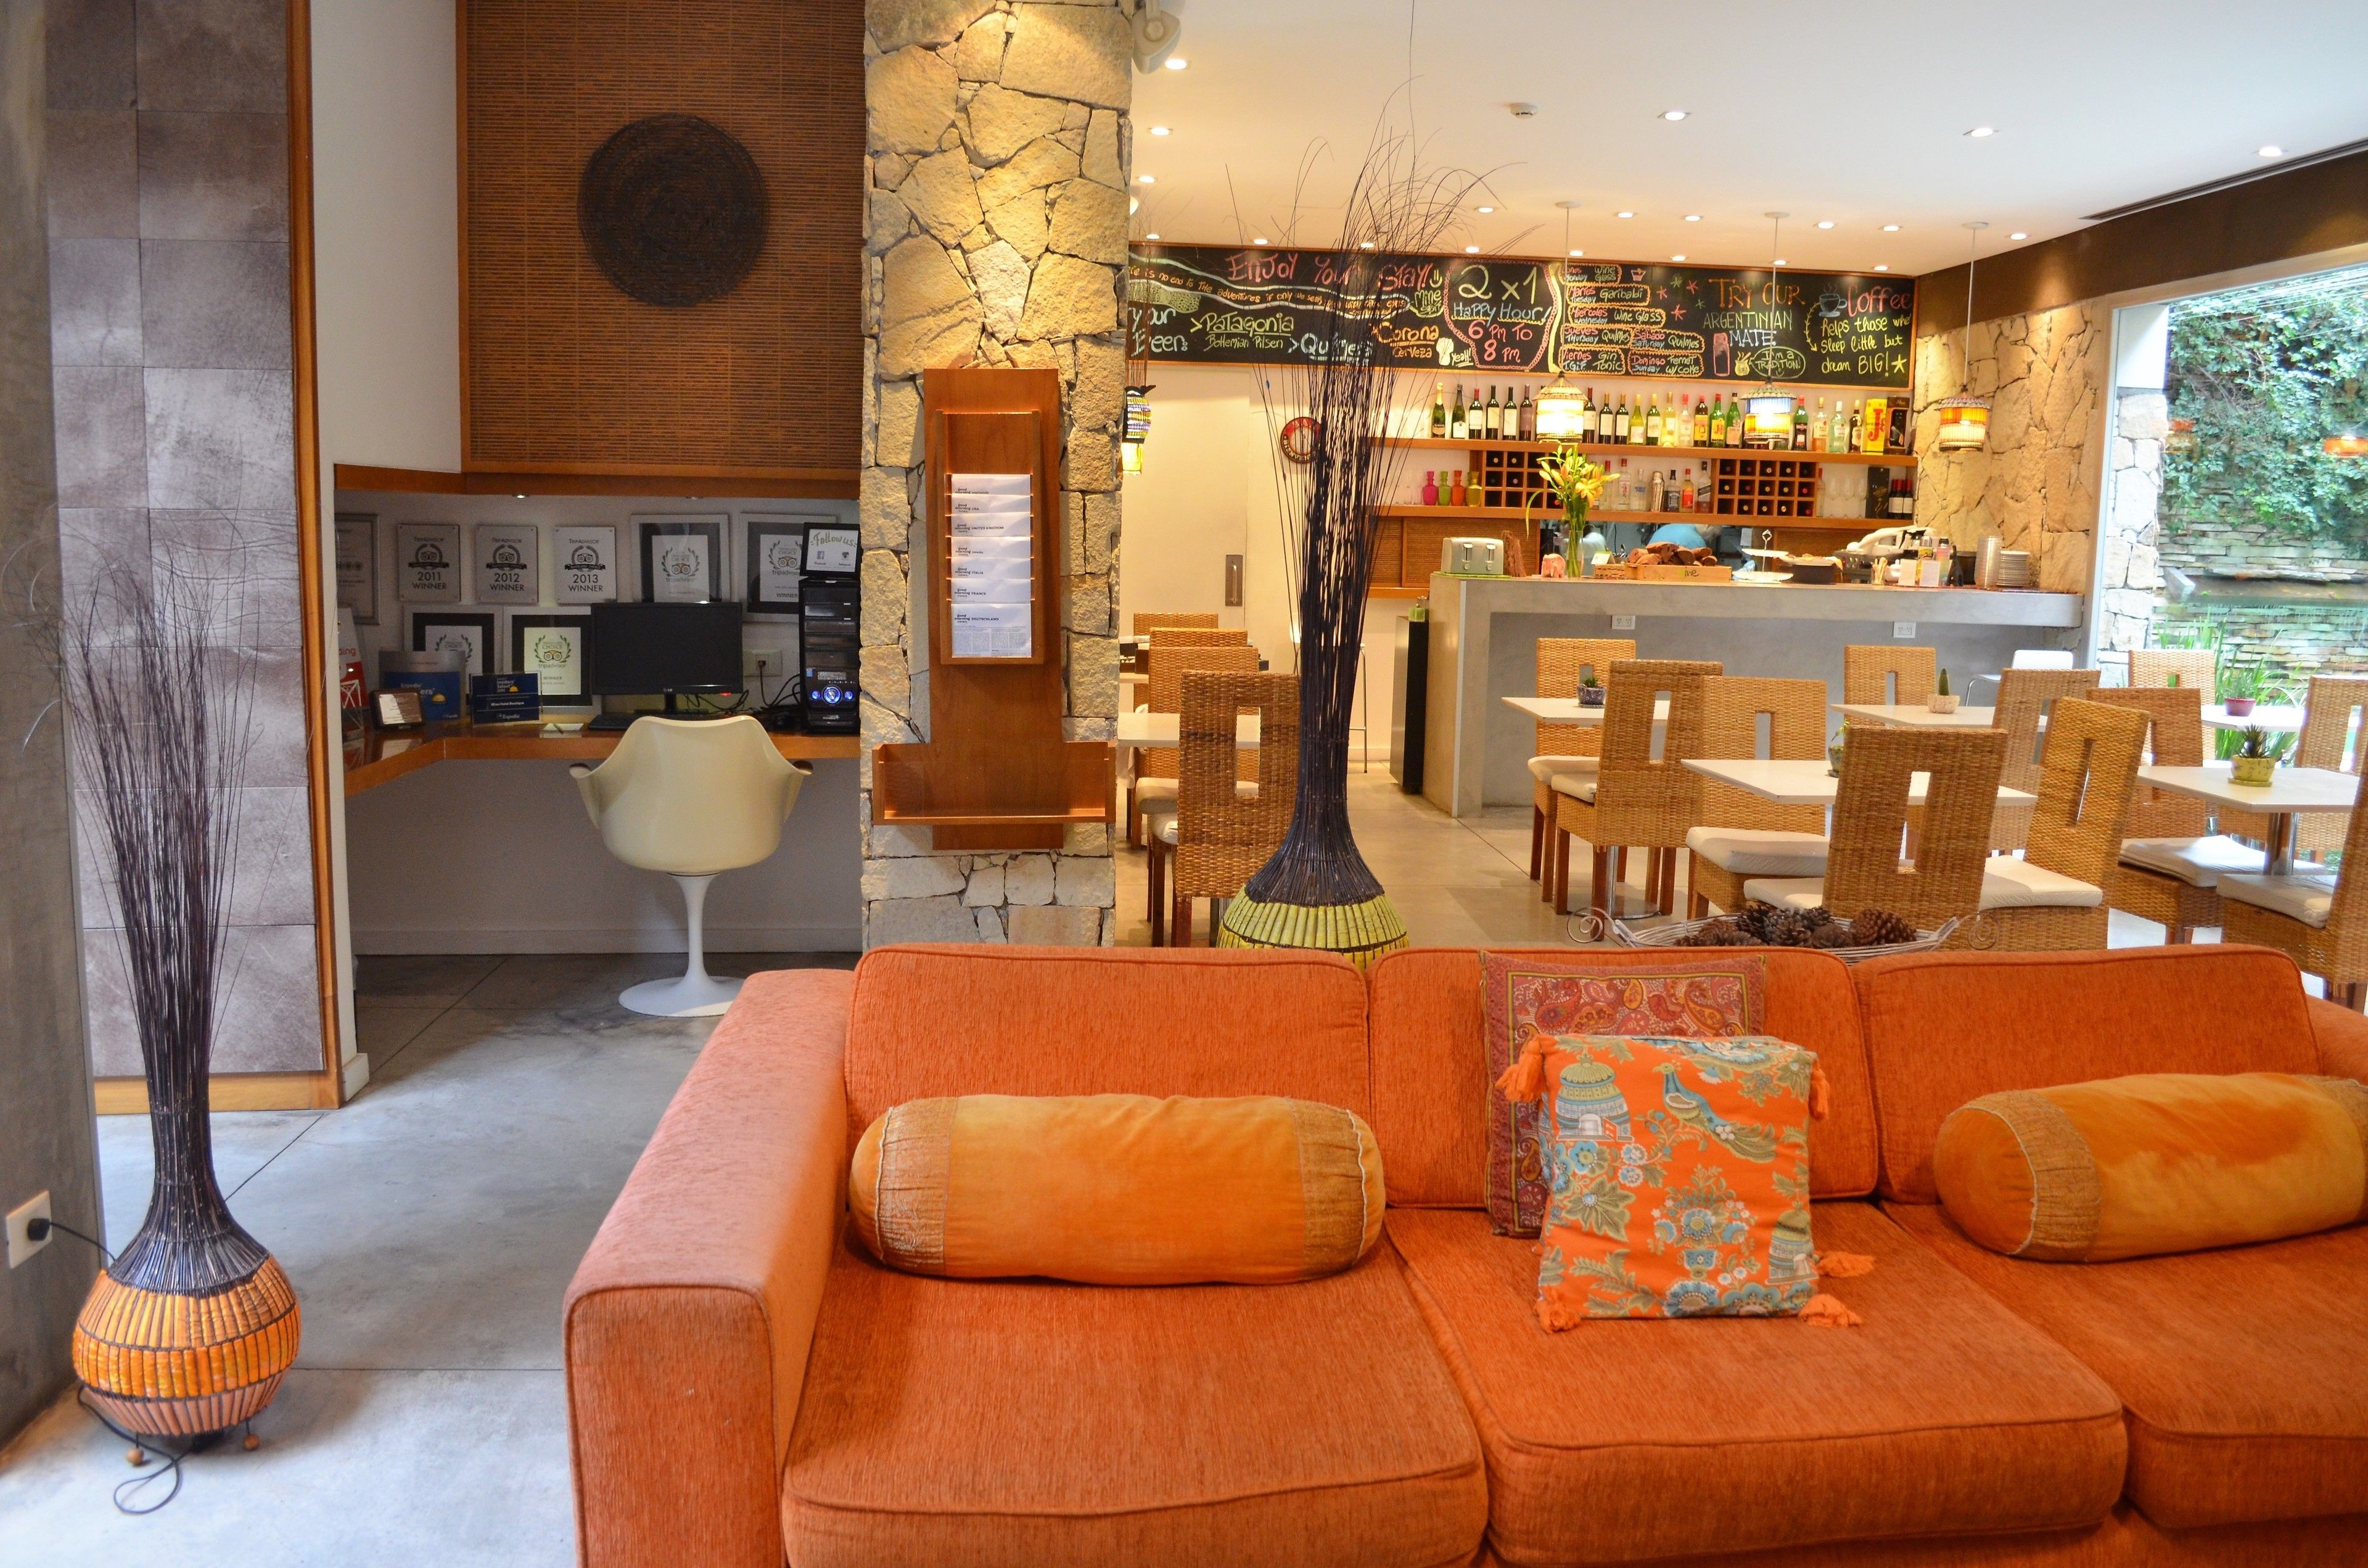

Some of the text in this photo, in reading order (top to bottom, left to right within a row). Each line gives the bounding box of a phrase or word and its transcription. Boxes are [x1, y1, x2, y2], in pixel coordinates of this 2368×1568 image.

[1145, 268, 1155, 278] is
[1266, 293, 1273, 302] if
[1276, 291, 1293, 302] only
[1600, 288, 1643, 302] Garibaldi
[1708, 279, 1754, 308] TRY
[1847, 283, 1912, 317] Coffee
[1453, 302, 1552, 327] Happy Hour!
[1614, 310, 1633, 321] Wine
[1635, 311, 1662, 324] Glass
[1703, 310, 1793, 330] ARGENTINIAN
[1468, 319, 1486, 339] 6
[1854, 316, 1888, 333] those
[1378, 322, 1439, 343] Corona
[1729, 329, 1777, 347] MATE
[1252, 335, 1283, 349] Pilsen
[1668, 335, 1700, 349] Quilmes
[1851, 334, 1877, 353] little
[1884, 334, 1903, 348] but
[1484, 339, 1497, 361] 8
[1598, 352, 1617, 363] Gin
[1592, 360, 1622, 371] Tonic
[1822, 351, 1889, 377] dream BIG!
[813, 532, 842, 546] Follow
[417, 572, 442, 581] 2011
[495, 573, 520, 583] 2012
[573, 574, 599, 583] 2013
[411, 582, 447, 590] WINNER
[490, 583, 524, 592] WINNER
